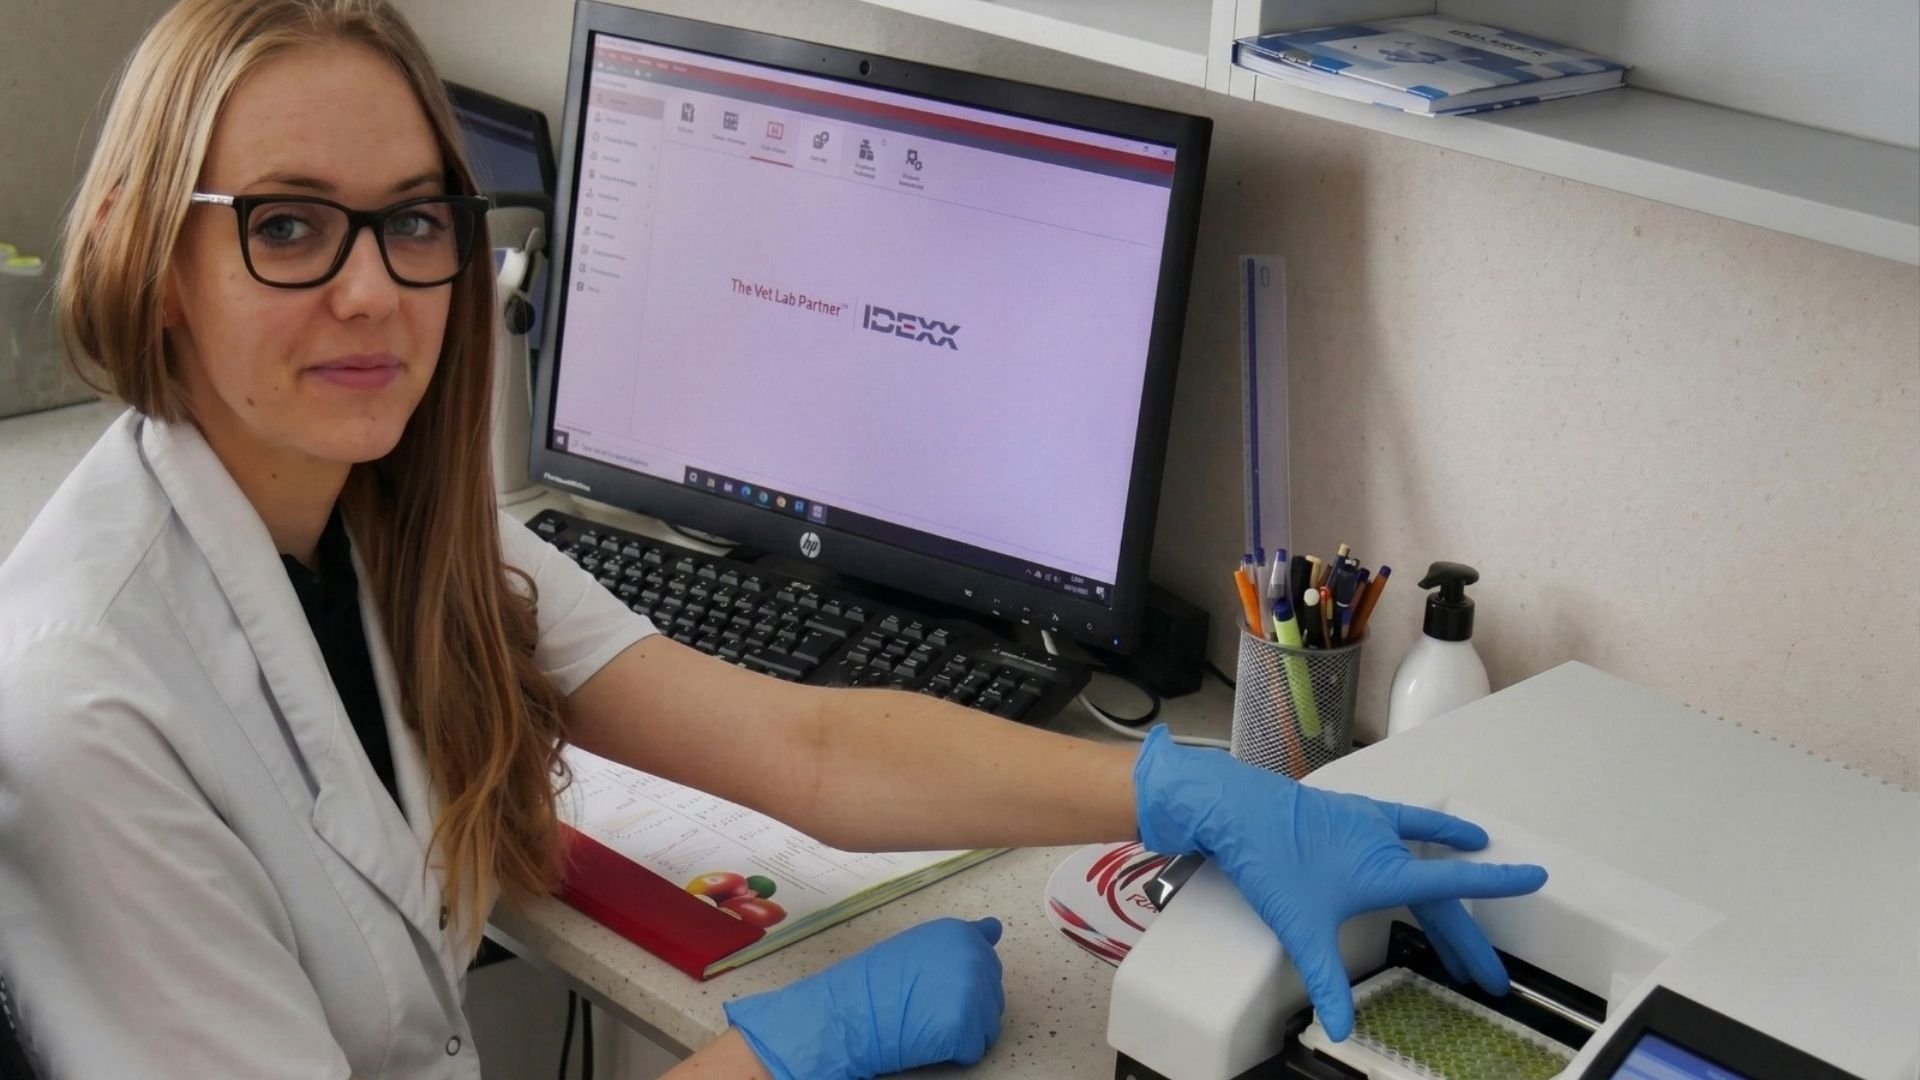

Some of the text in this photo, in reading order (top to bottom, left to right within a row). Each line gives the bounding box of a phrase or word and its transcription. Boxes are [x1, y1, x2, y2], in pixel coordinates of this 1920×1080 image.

[731, 278, 752, 296] The
[754, 283, 773, 301] Vet
[775, 288, 796, 306] Lab
[863, 304, 961, 350] IDEXX
[801, 532, 820, 557] hp
